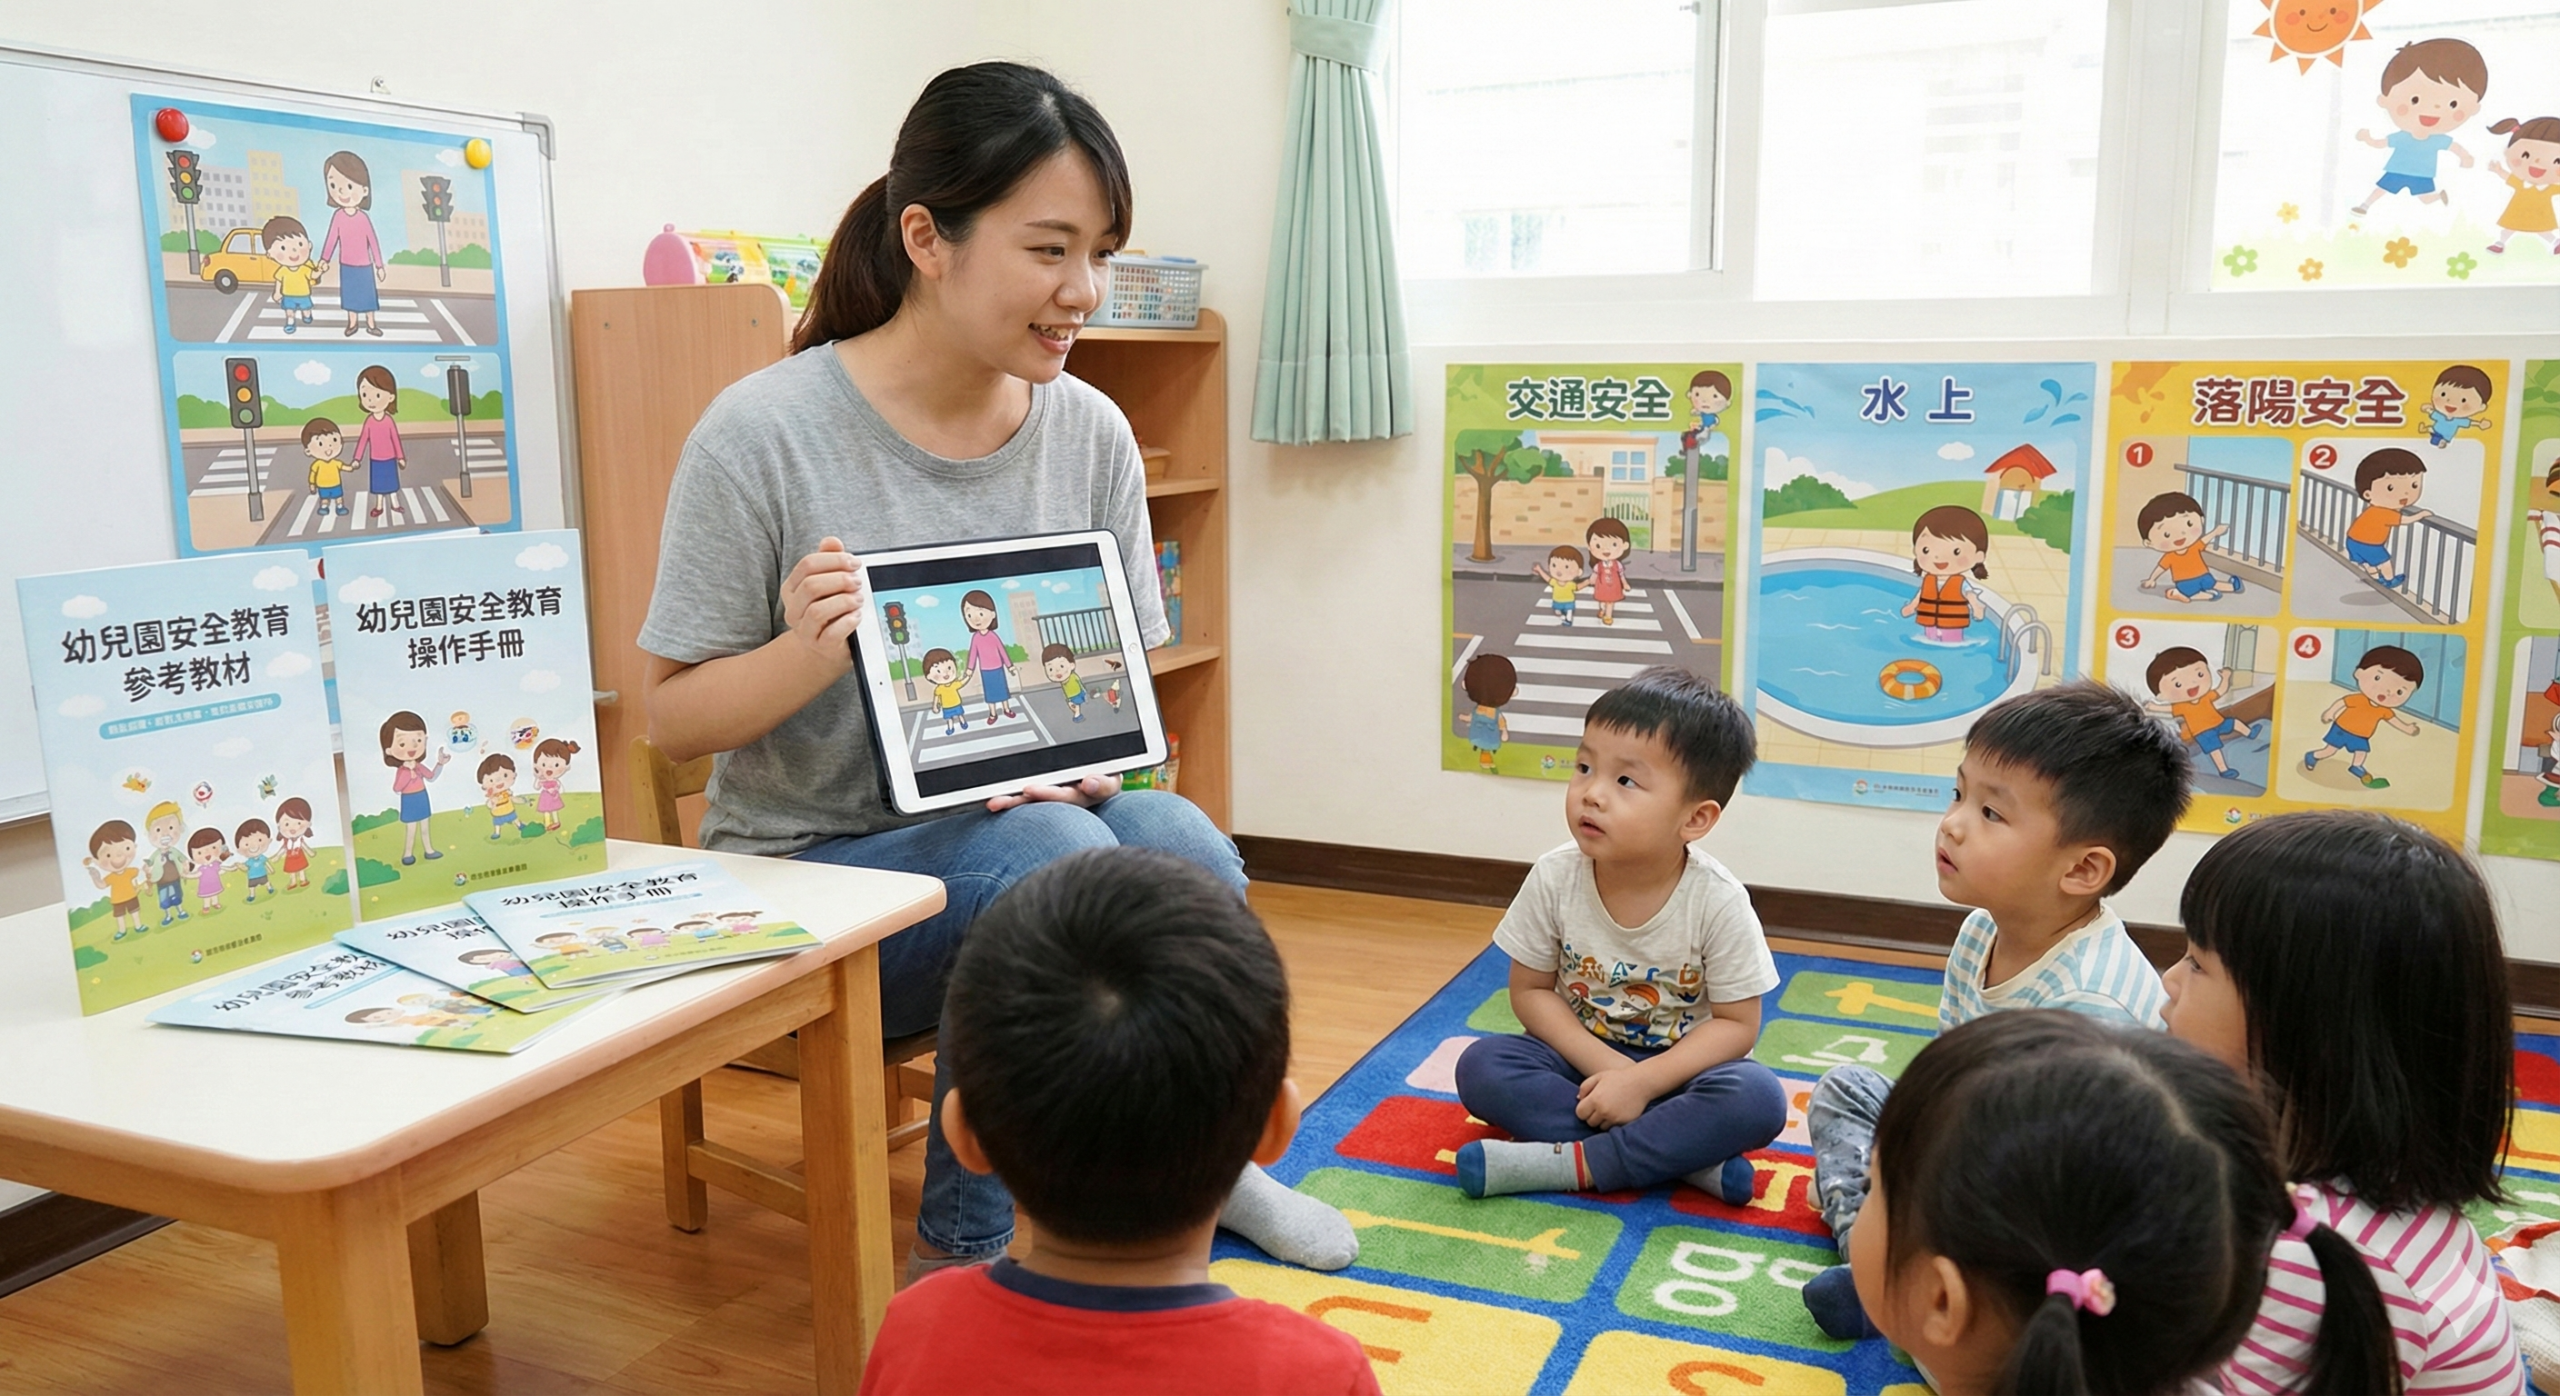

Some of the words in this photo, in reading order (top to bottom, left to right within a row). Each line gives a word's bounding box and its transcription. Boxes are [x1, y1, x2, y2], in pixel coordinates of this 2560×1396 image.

[1508, 378, 1671, 419] 交通安全
[2195, 378, 2406, 424] 落陽安全
[356, 586, 562, 633] 幼兒園安全教育
[61, 604, 289, 664] 幼兒園安全教育
[408, 629, 525, 669] 操作手冊
[123, 651, 251, 702] 參考教材
